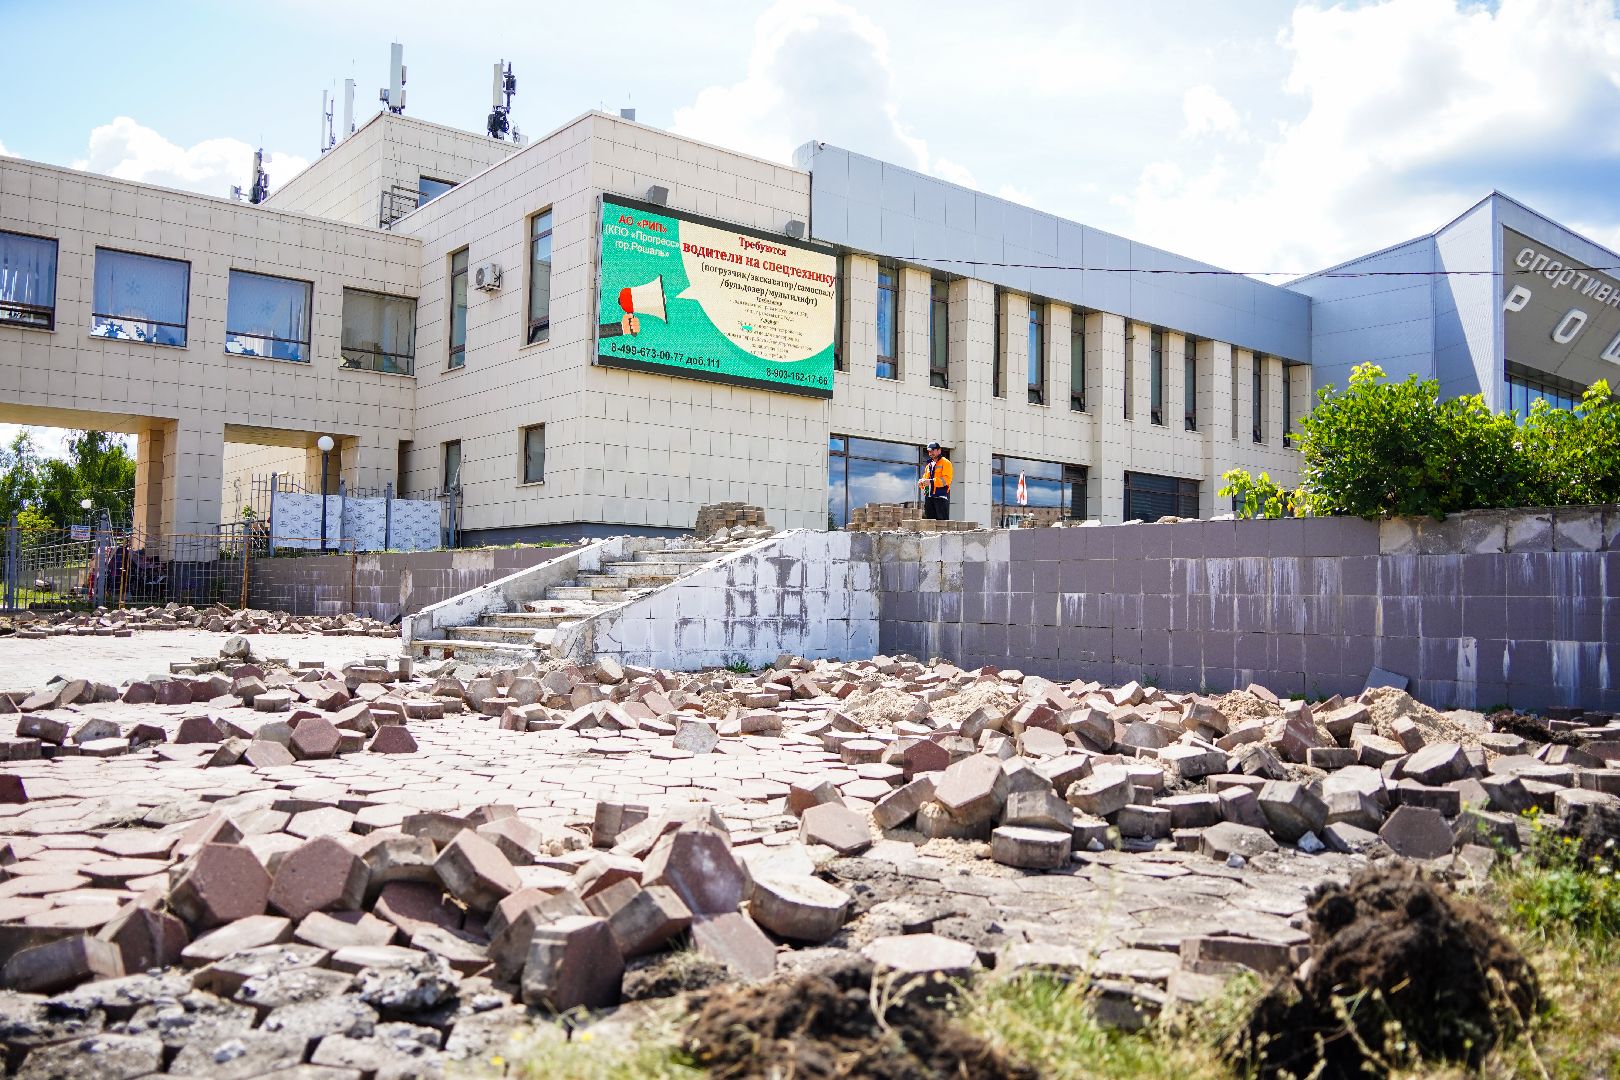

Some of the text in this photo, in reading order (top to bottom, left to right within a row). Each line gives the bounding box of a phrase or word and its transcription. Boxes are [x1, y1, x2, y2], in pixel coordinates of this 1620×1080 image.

[605, 224, 629, 237] (КПО
[618, 214, 667, 233] АО «РИП»
[739, 237, 787, 257] Требуются
[682, 242, 836, 287] водители на спецтехнику
